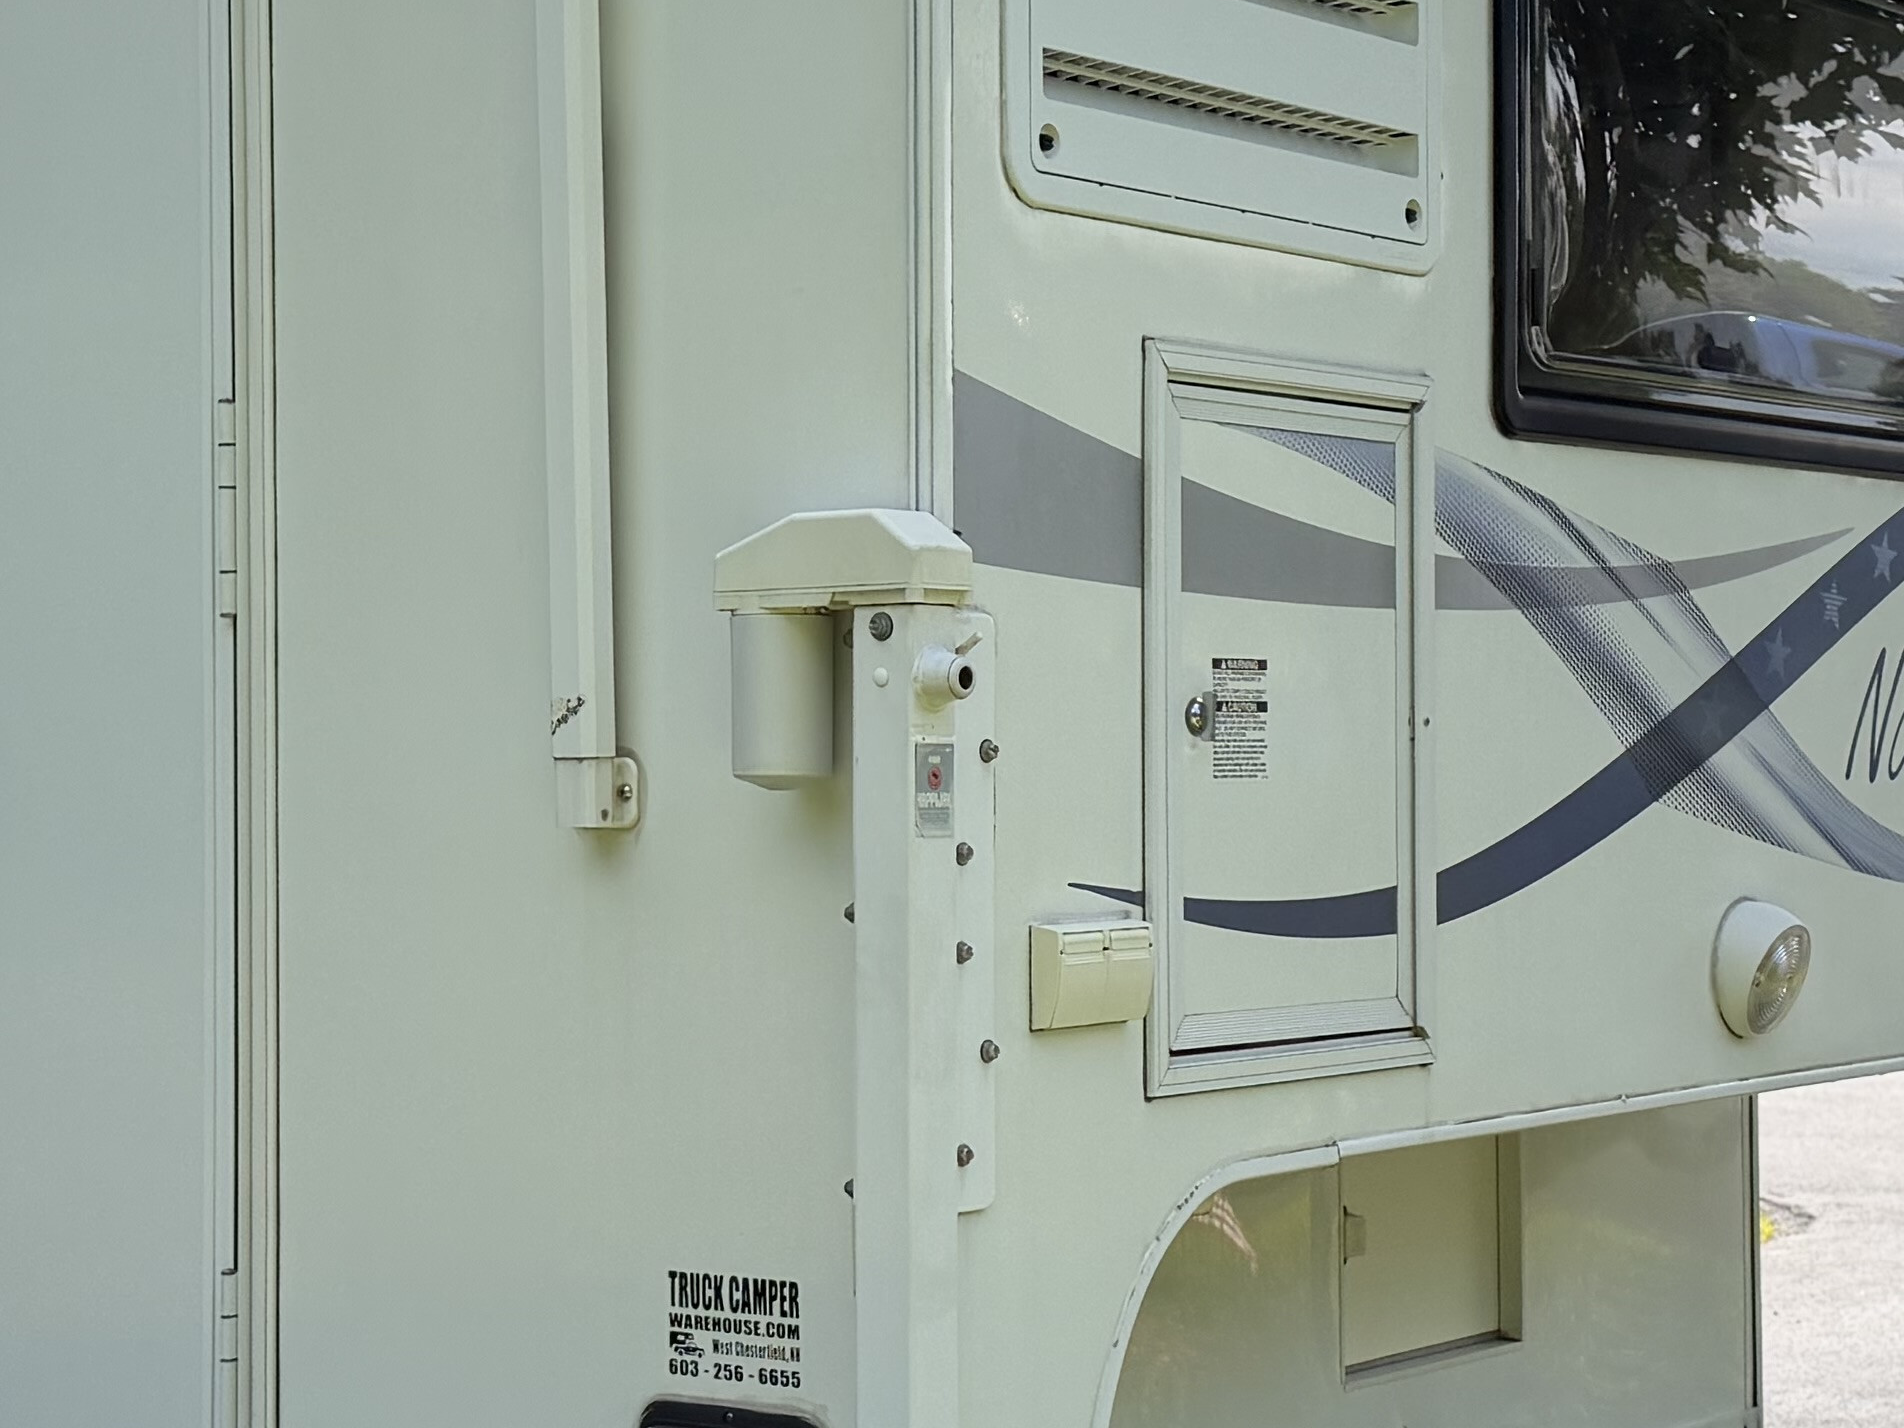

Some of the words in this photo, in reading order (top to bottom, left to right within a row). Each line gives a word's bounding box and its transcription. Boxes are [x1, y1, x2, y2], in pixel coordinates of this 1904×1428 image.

[668, 1270, 725, 1312] TRUCK
[729, 1275, 800, 1319] CAMPER
[668, 1312, 800, 1341] WAREHOUSE.COM
